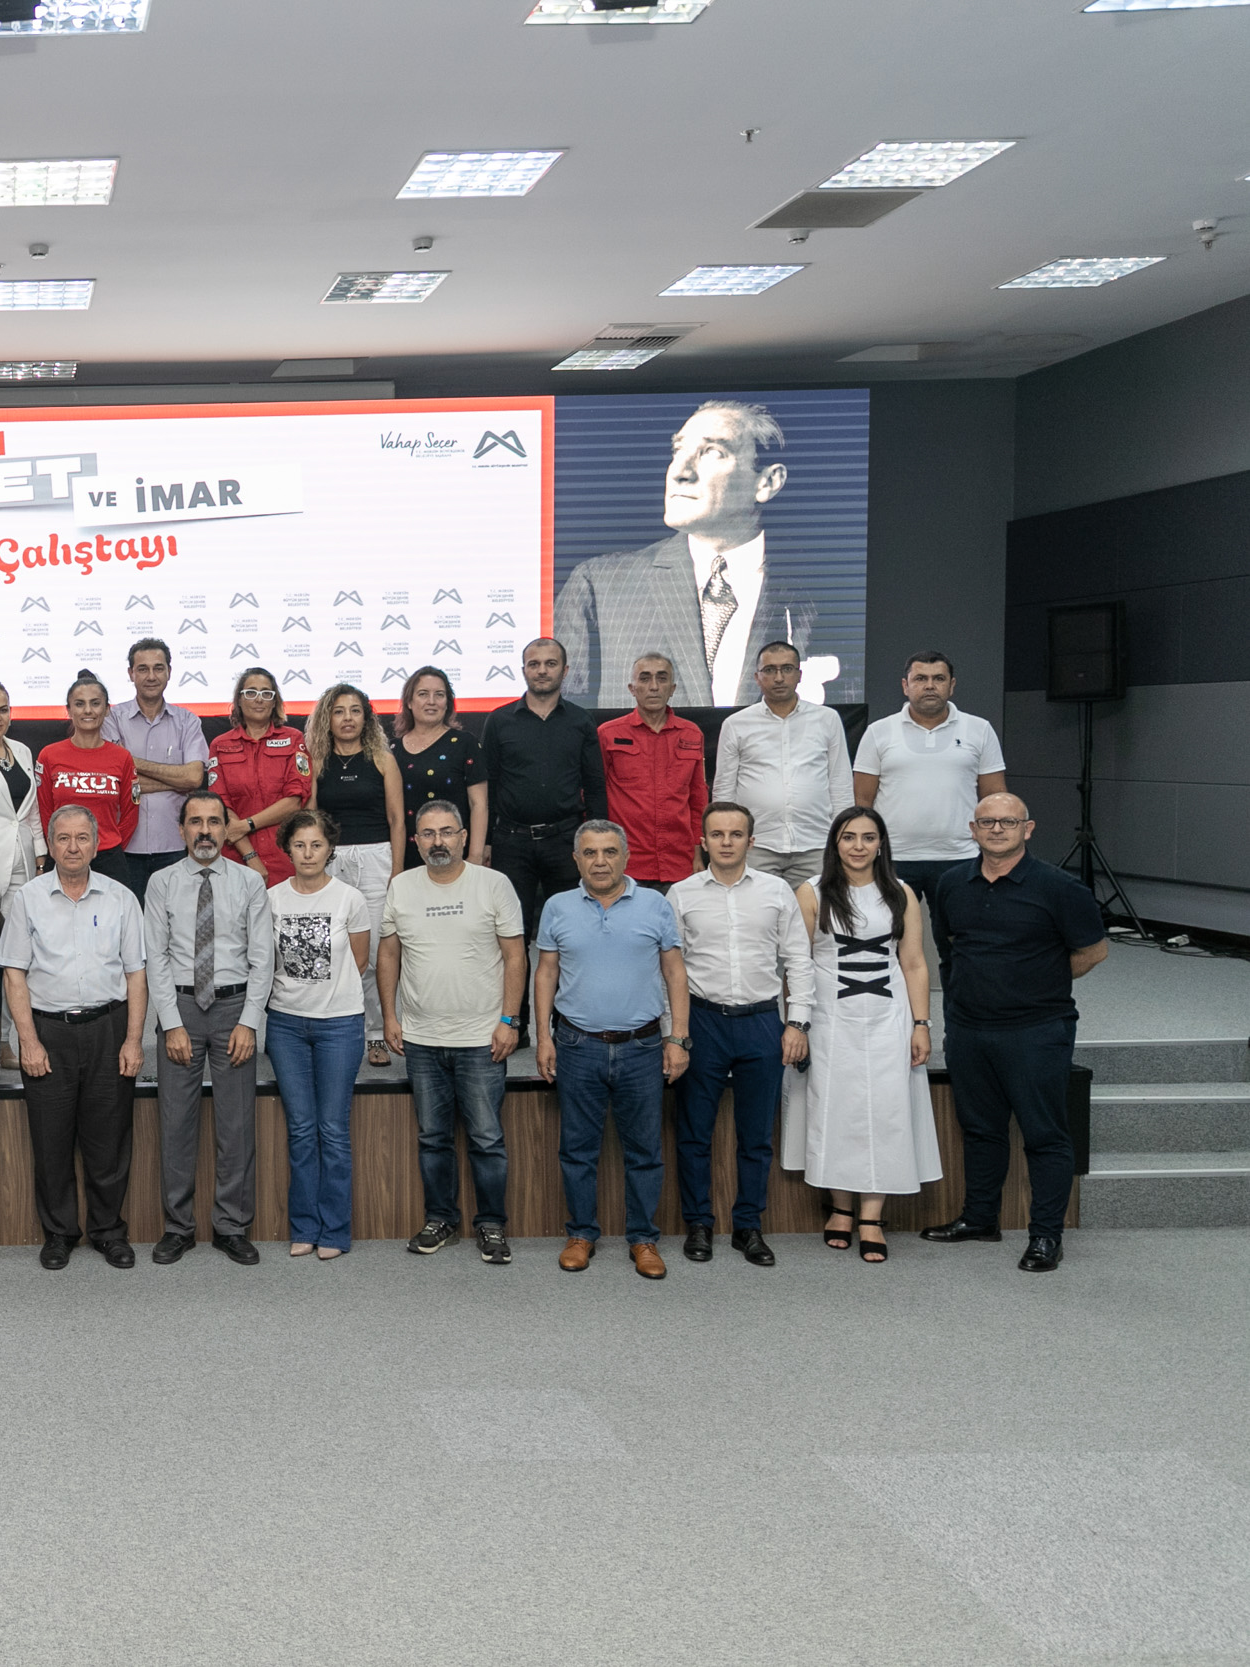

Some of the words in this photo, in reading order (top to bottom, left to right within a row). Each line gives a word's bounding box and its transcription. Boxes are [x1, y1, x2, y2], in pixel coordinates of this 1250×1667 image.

[380, 431, 421, 457] Vahap
[88, 491, 118, 507] VE
[135, 477, 243, 513] İMAR
[54, 773, 120, 790] AKUT
[426, 901, 463, 917] mavi
